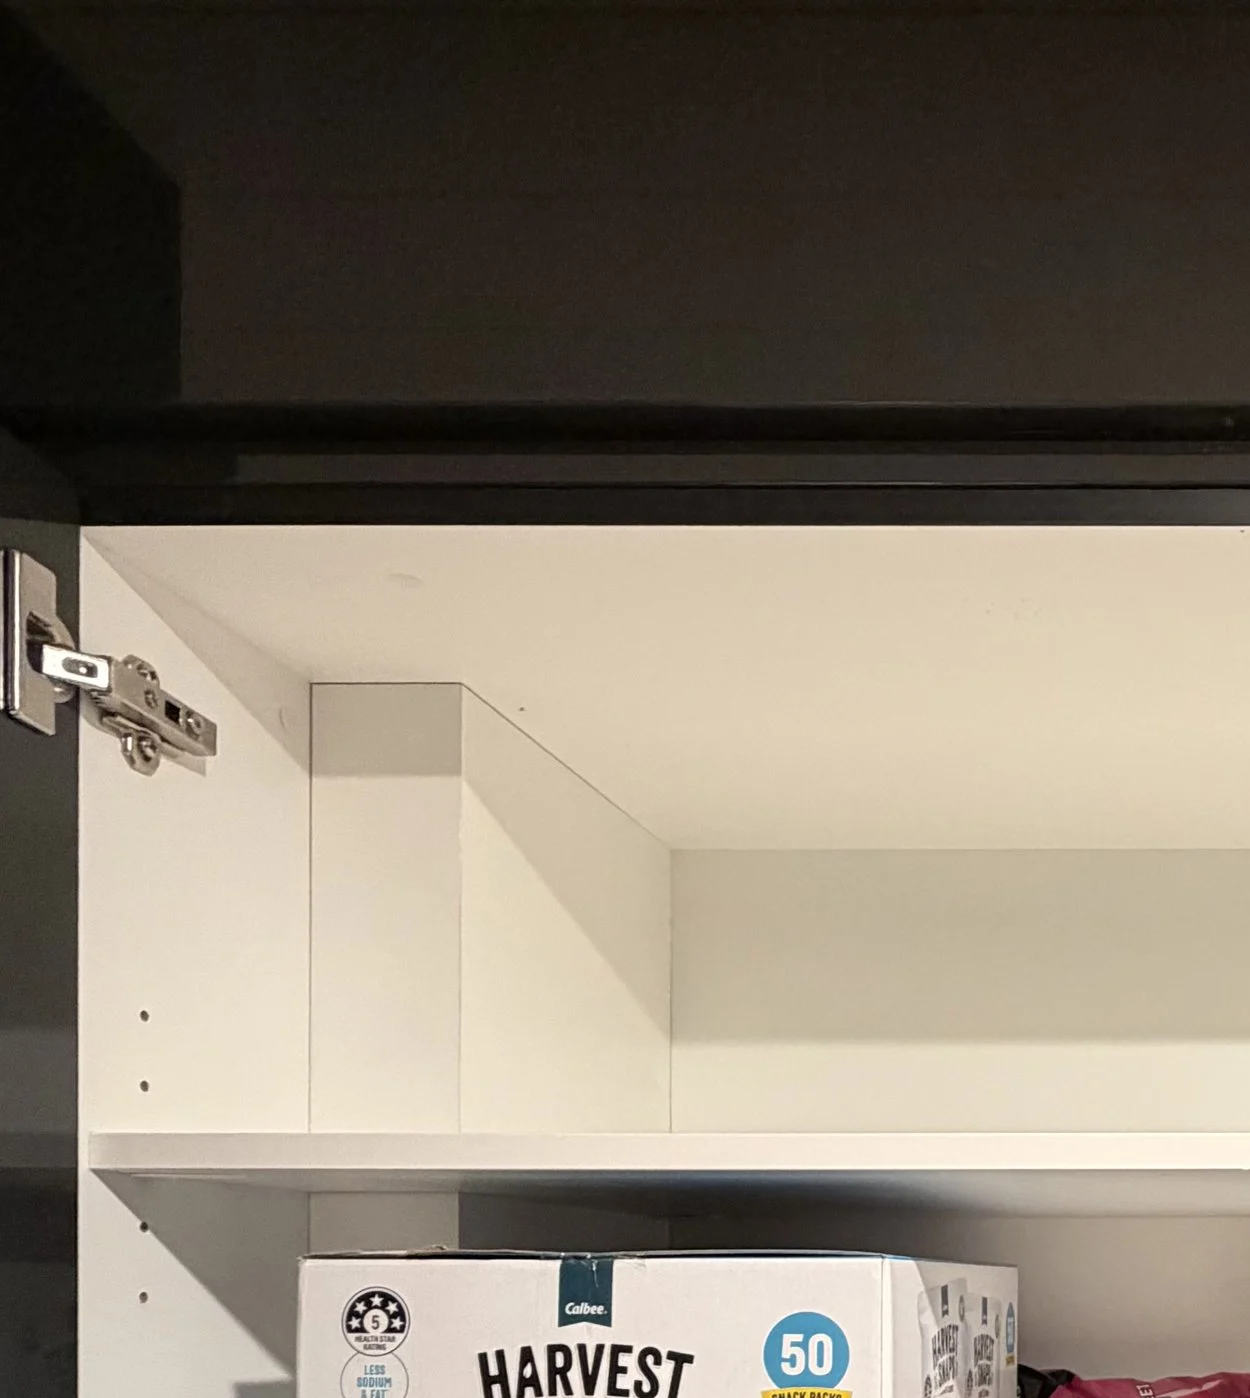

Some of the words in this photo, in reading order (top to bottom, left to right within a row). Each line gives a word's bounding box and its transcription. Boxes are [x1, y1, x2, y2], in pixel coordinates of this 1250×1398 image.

[370, 1314, 380, 1331] 5
[780, 1333, 834, 1377] 50
[364, 1364, 386, 1375] LESS
[356, 1377, 392, 1388] SODIUM
